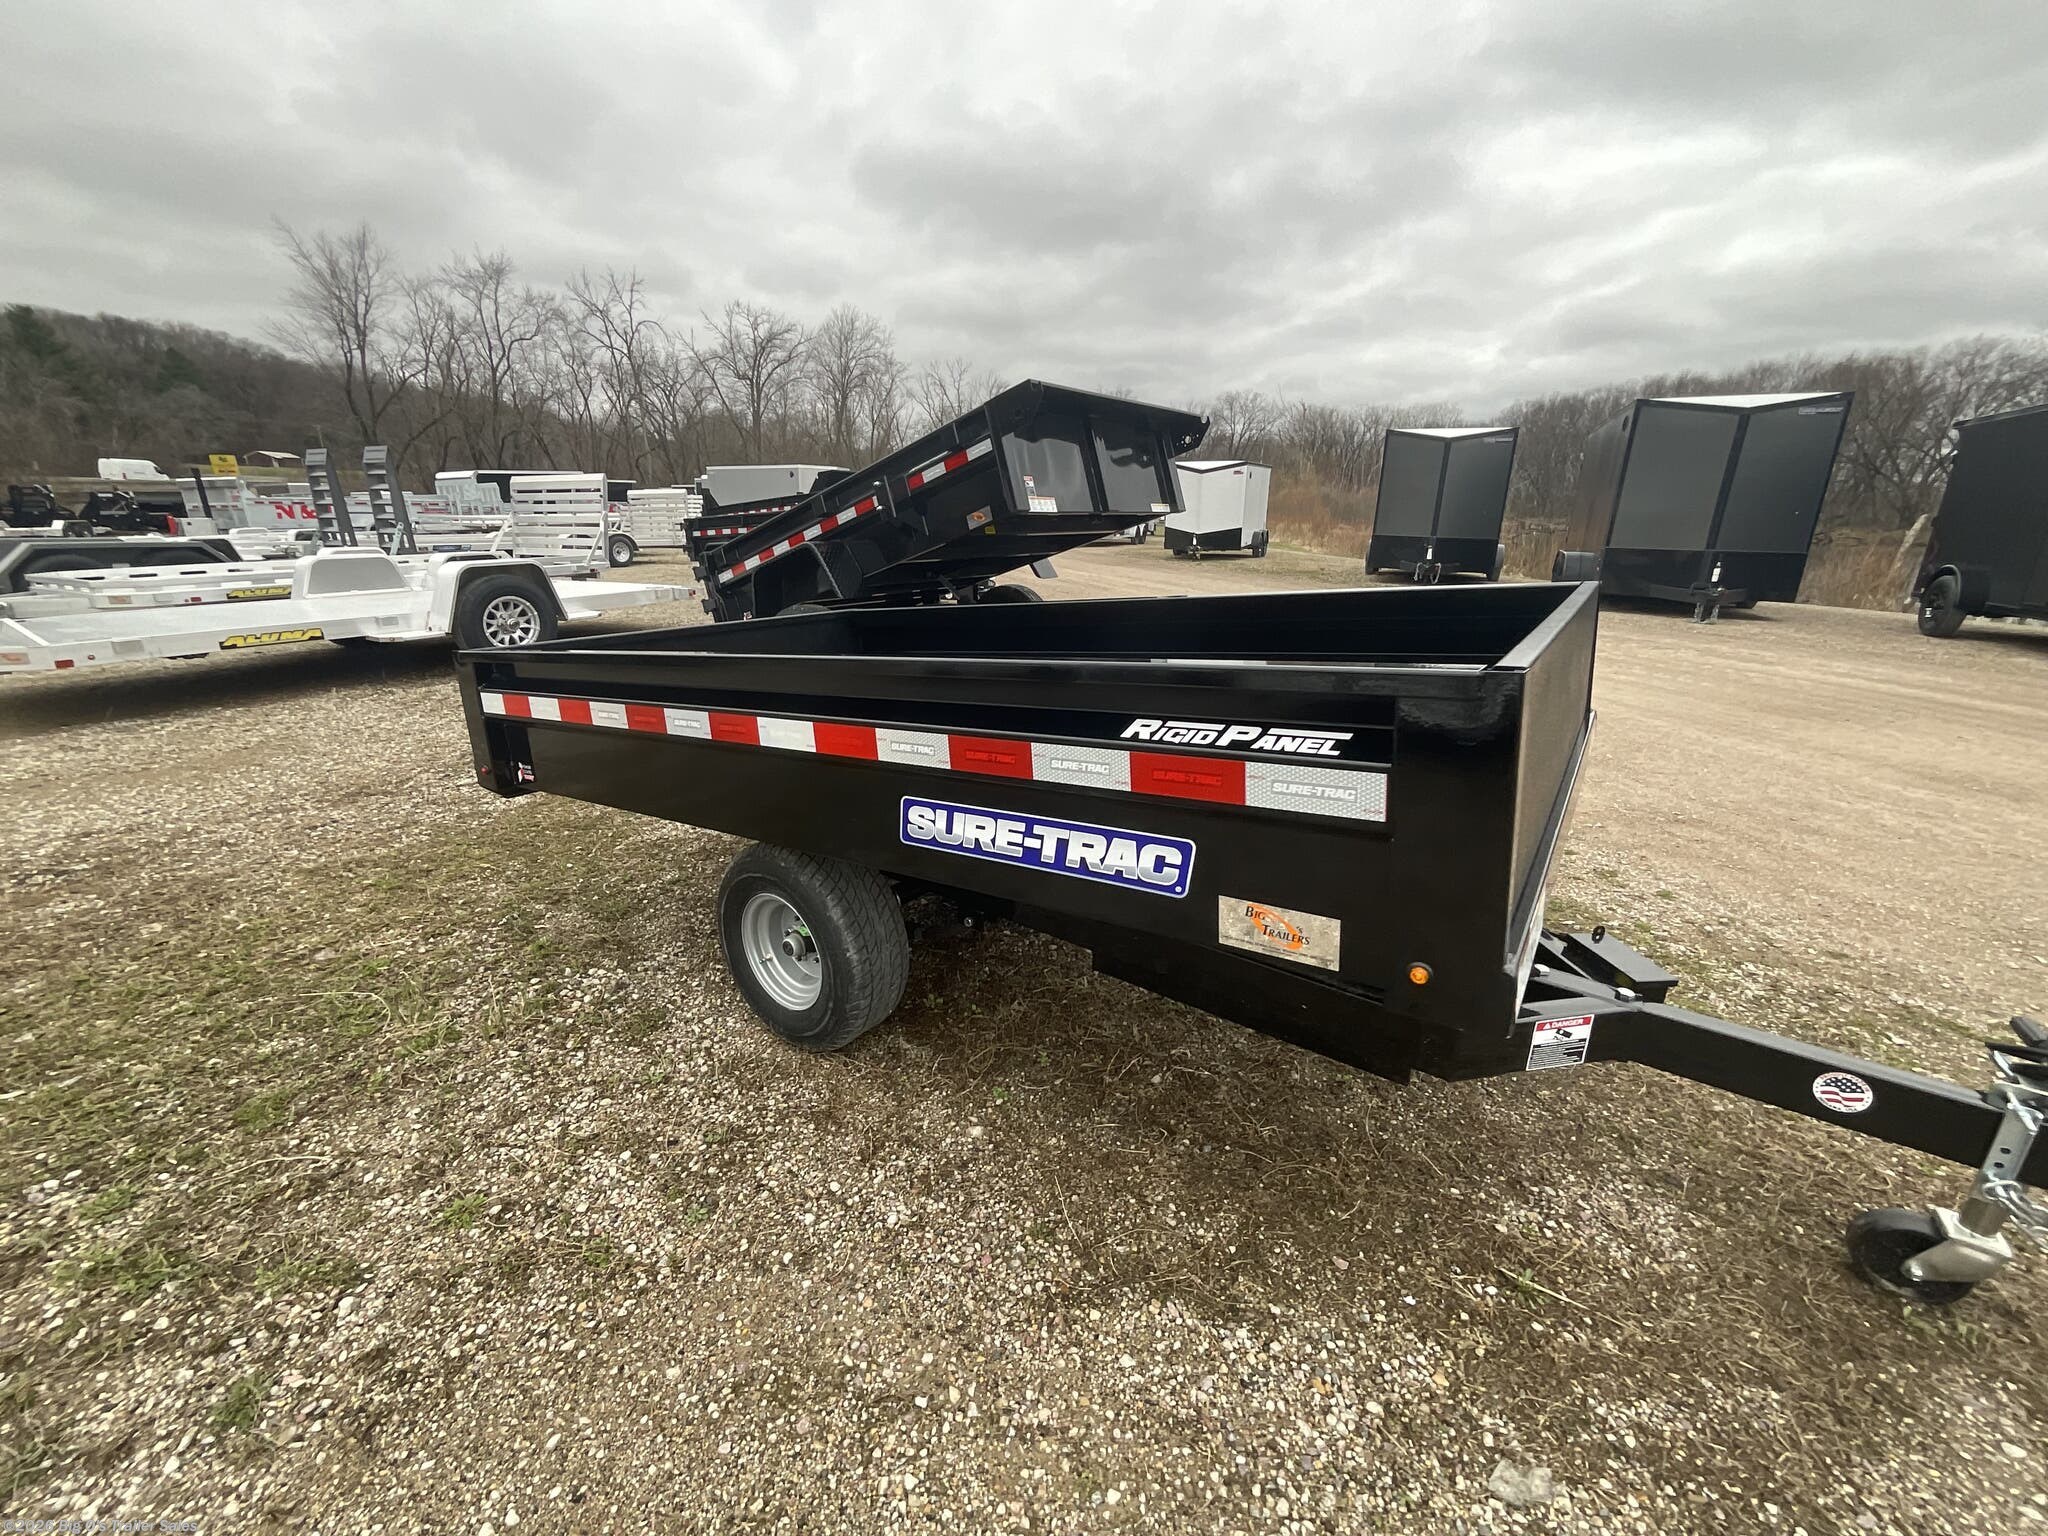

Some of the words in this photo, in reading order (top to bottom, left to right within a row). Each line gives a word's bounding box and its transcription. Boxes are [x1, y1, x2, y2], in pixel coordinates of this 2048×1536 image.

[223, 629, 322, 648] ALUMA
[1120, 718, 1225, 745] RIGID
[1215, 725, 1353, 755] PANEL
[891, 742, 935, 756] SURE-TRAC
[1051, 759, 1110, 775] SURE-TRAC
[1272, 782, 1356, 800] SURE-TRAC
[907, 805, 1182, 886] SURE-TRAC
[1261, 924, 1311, 946] TRAILERS
[1551, 1018, 1584, 1029] DANGER
